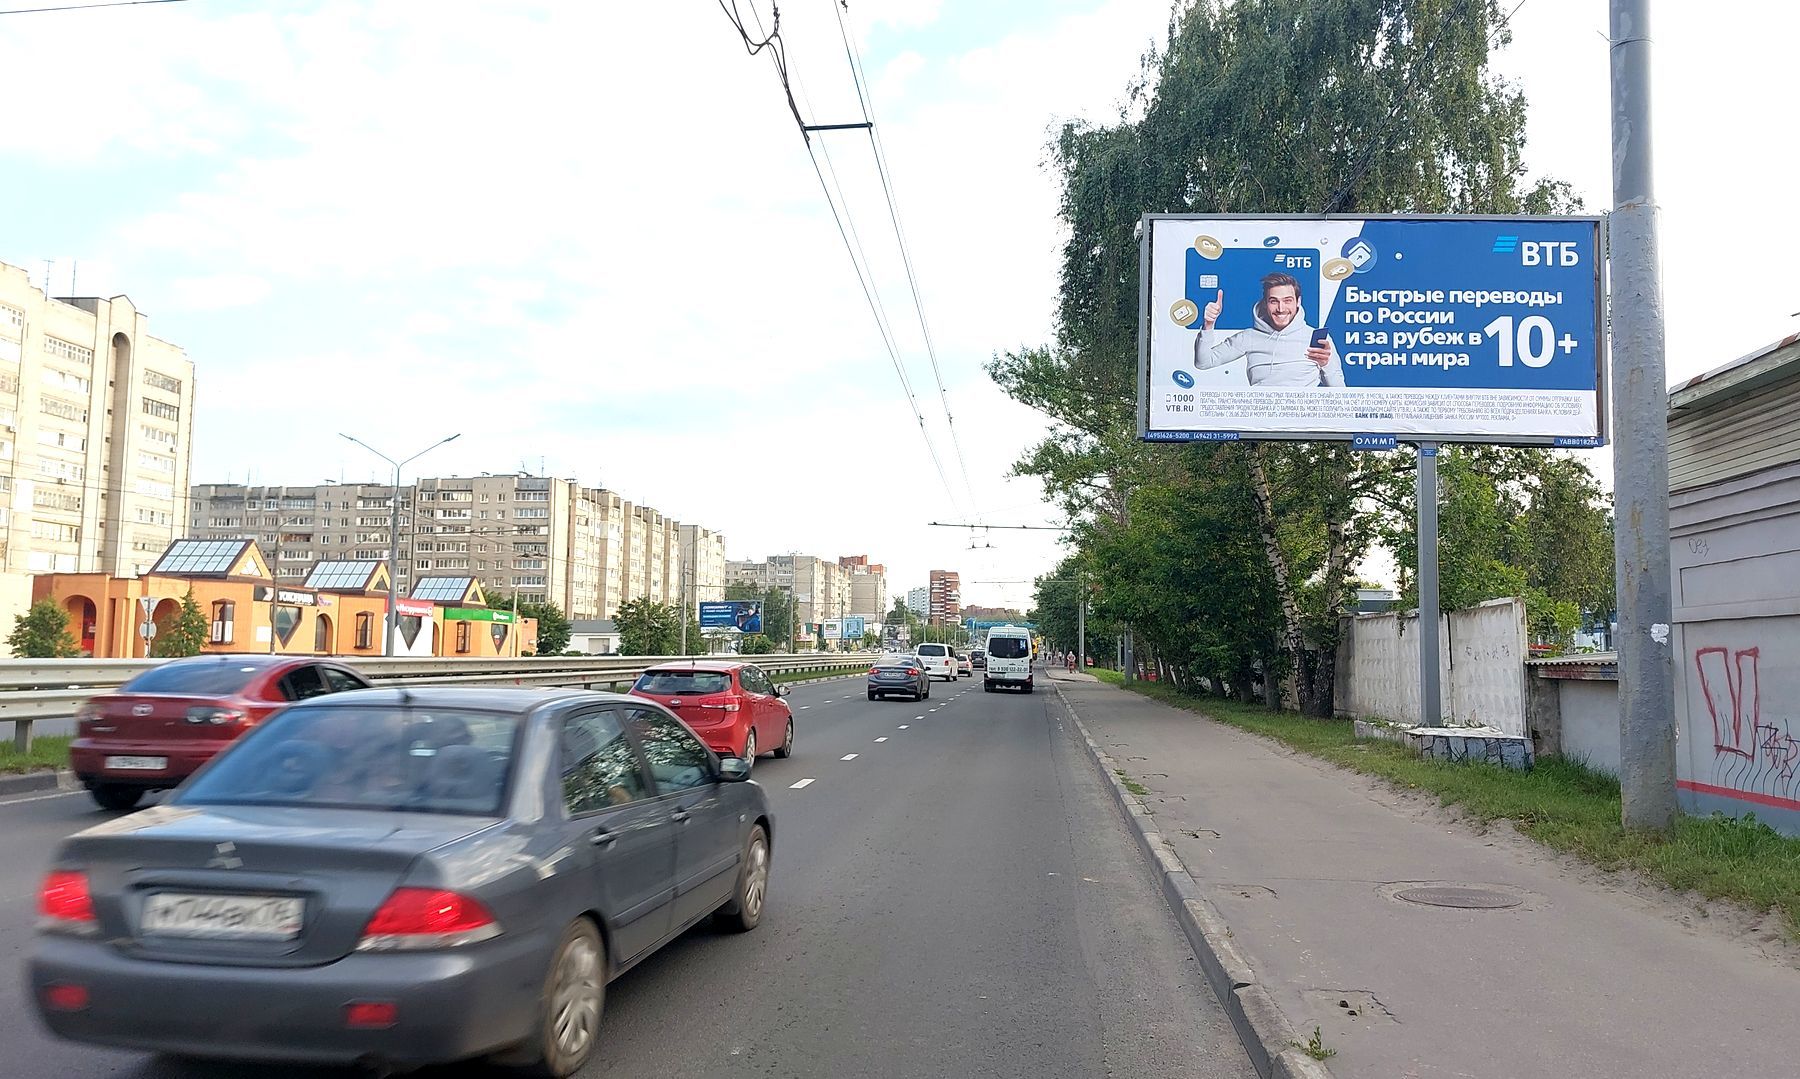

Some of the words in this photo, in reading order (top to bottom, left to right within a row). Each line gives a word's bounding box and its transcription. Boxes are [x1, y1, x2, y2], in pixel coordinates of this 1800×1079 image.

[1286, 256, 1312, 268] ВТБ
[1522, 242, 1579, 267] ВТБ
[1346, 286, 1444, 308] Быстрые
[1449, 290, 1562, 308] переводы
[1346, 311, 1374, 324] по
[1378, 308, 1454, 324] России
[1346, 332, 1360, 344] и
[1364, 332, 1388, 345] за
[1393, 327, 1464, 349] рубеж
[1468, 332, 1482, 346] в
[1482, 316, 1578, 368] 10+
[1344, 352, 1406, 370] стран
[1412, 352, 1470, 371] мира
[1172, 394, 1194, 402] 1000
[1166, 404, 1194, 412] VTB.RU
[1193, 432, 1212, 440] (4942)
